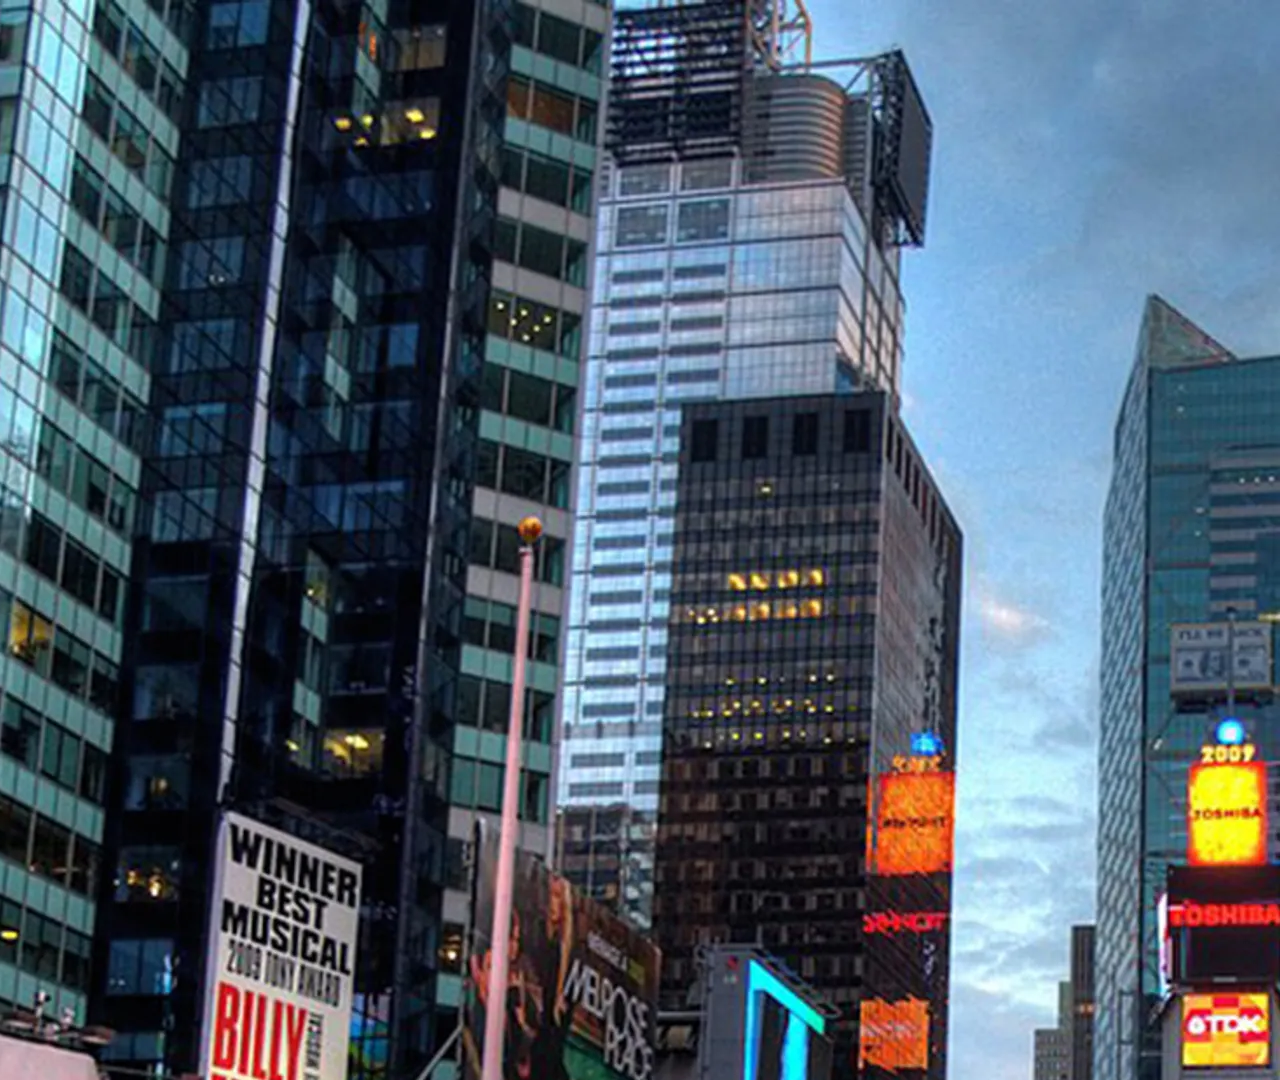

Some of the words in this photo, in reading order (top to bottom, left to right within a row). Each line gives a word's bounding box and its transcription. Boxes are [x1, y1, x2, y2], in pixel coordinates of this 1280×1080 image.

[230, 823, 358, 909] WINNER
[256, 875, 328, 930] BEST
[1170, 902, 1280, 927] TOSHIBA
[221, 899, 351, 976] MUSICAL
[1206, 1014, 1262, 1033] TDK
